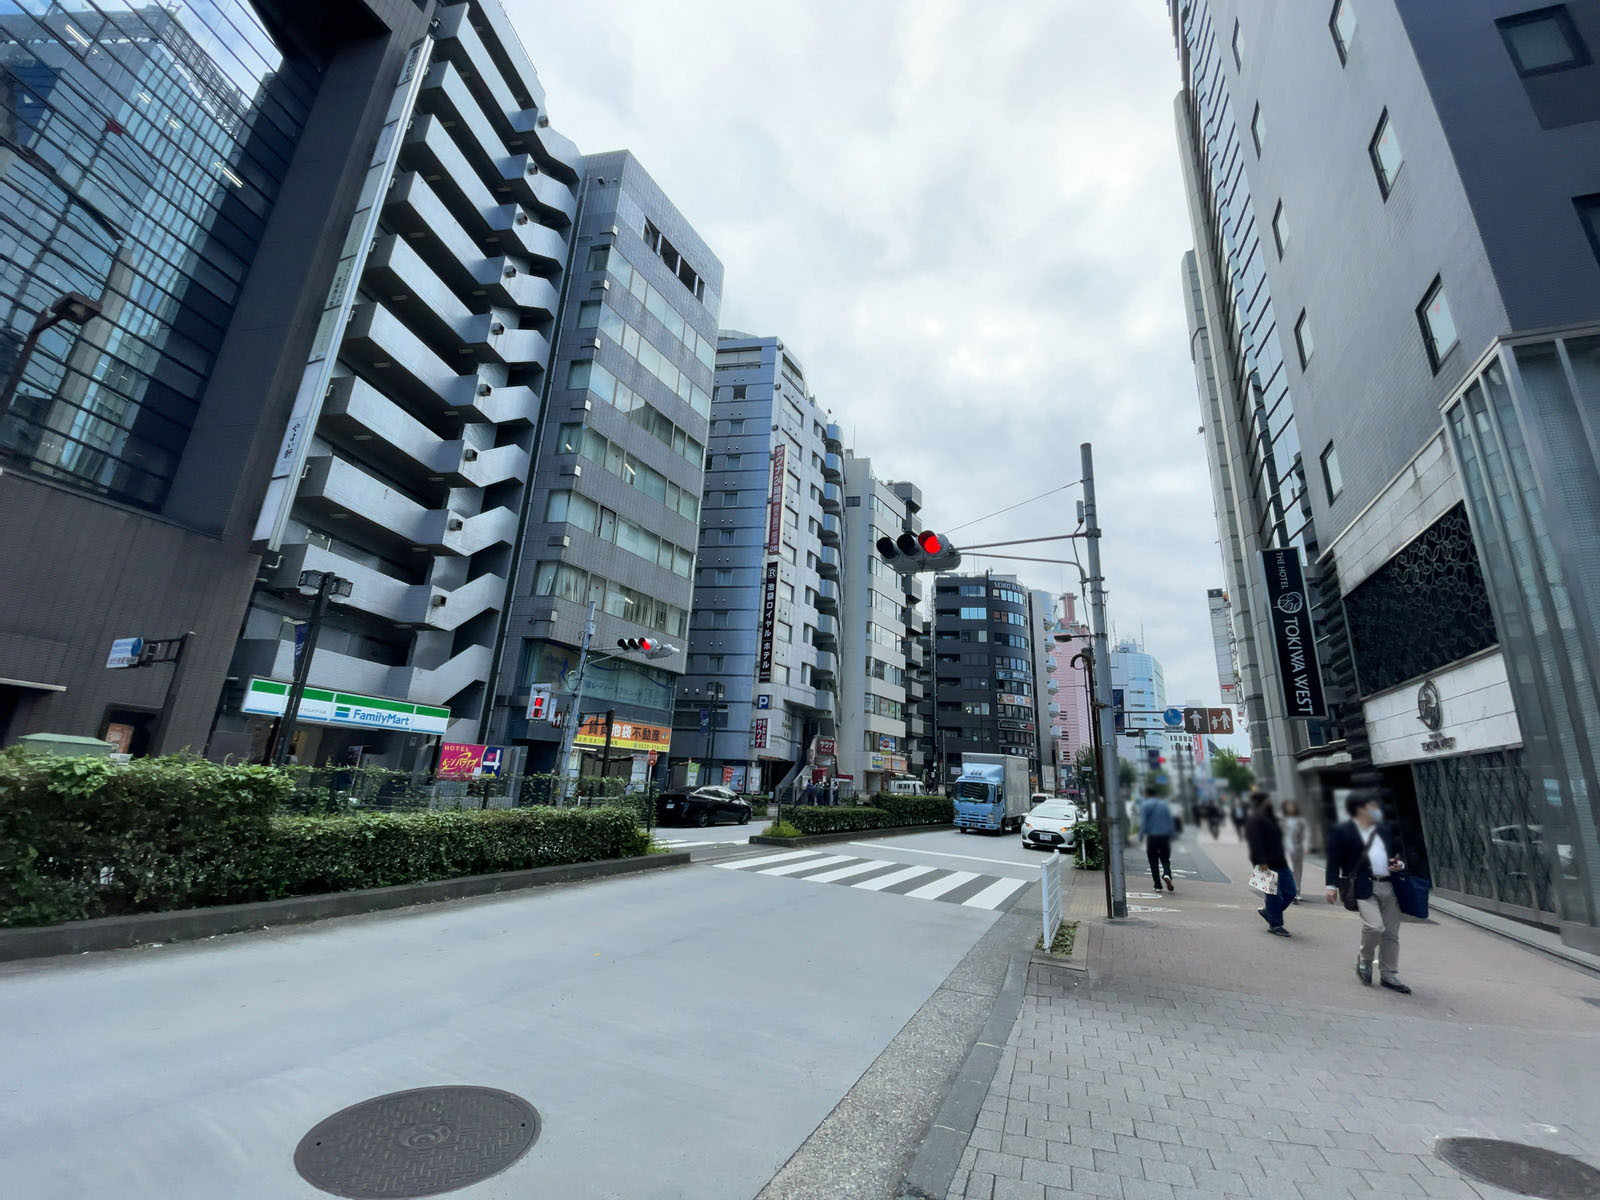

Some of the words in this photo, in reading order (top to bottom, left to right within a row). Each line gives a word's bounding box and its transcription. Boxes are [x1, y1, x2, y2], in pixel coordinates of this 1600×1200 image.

[1276, 552, 1284, 565] THE
[1278, 566, 1288, 589] HOTEL
[1283, 617, 1305, 673] TOKIWA
[1294, 674, 1313, 715] WEST
[759, 696, 768, 708] P
[353, 709, 410, 726] FamilyMart
